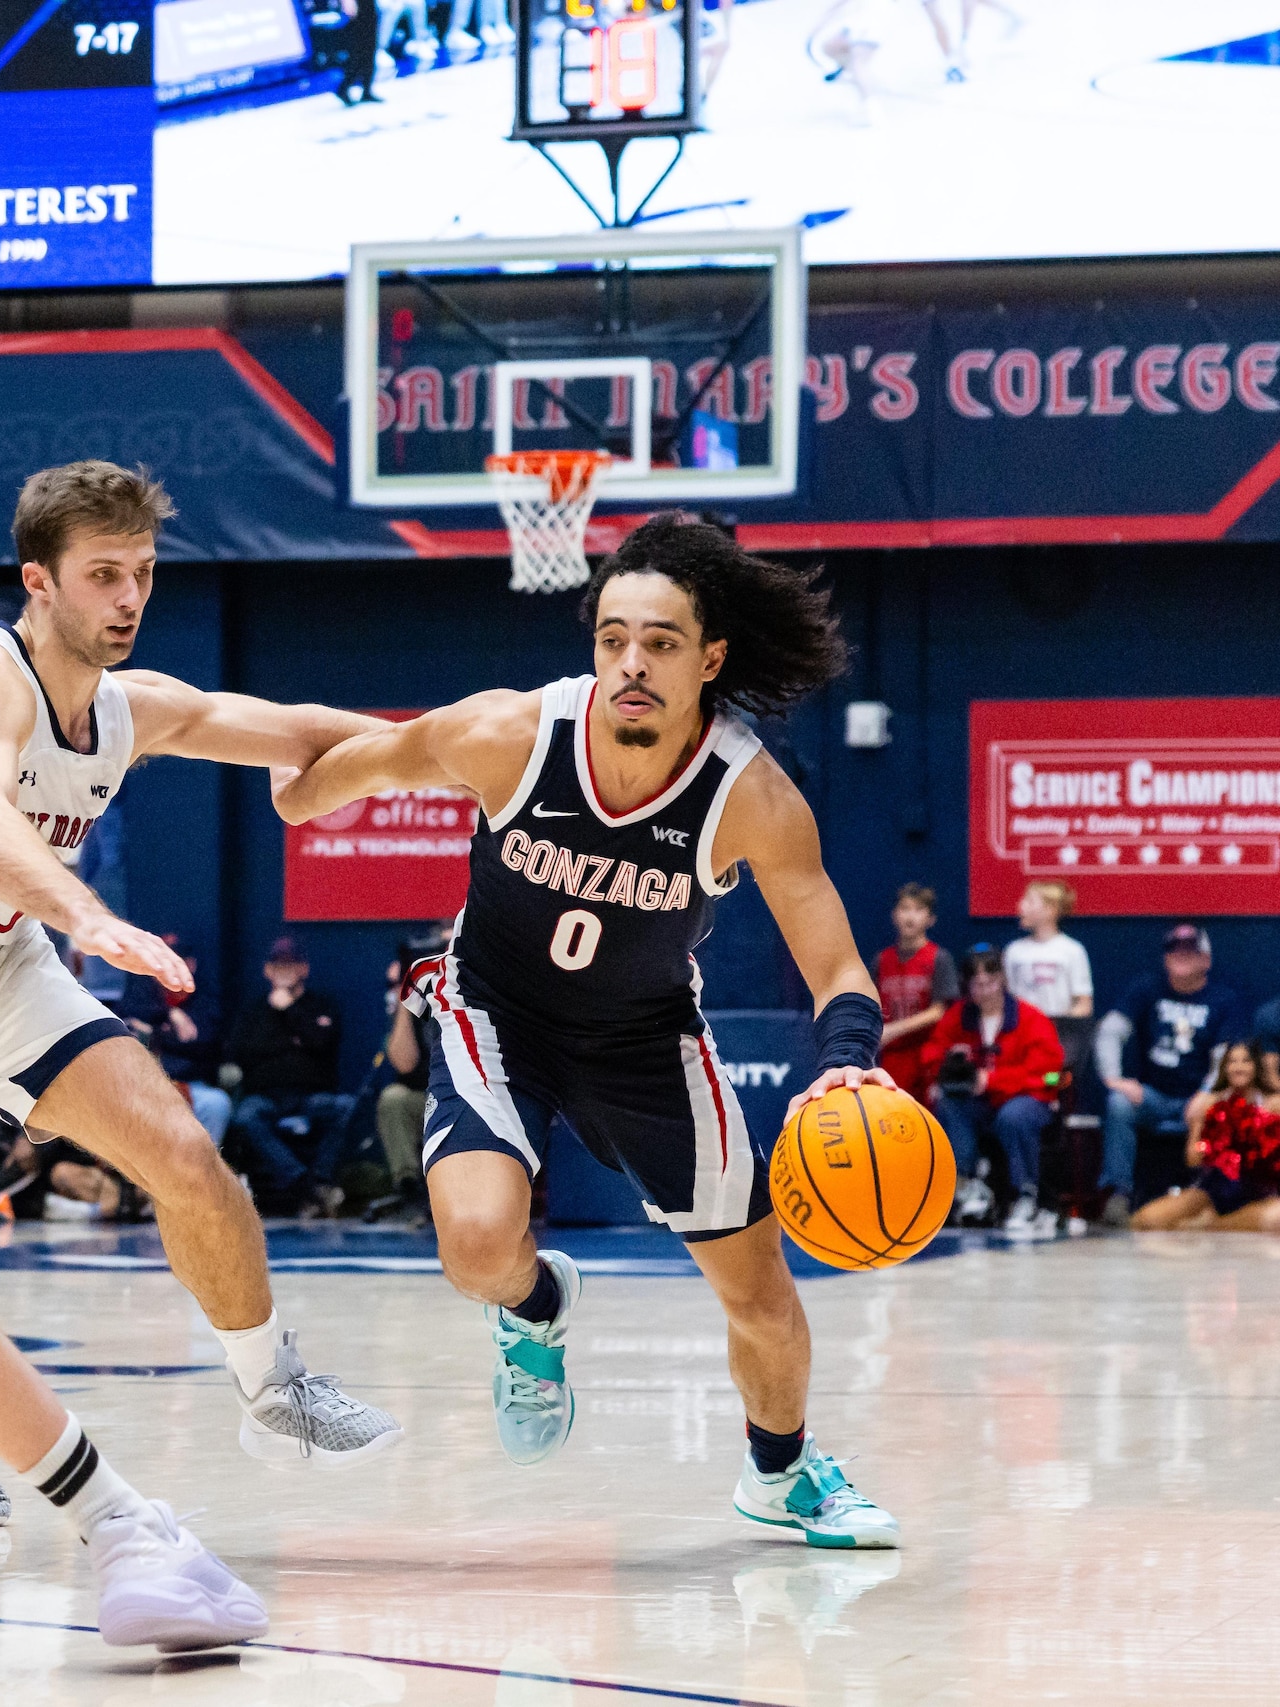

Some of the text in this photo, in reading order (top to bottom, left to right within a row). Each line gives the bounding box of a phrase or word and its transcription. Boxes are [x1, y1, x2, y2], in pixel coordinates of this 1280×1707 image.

[74, 22, 140, 56] 7-17
[948, 342, 1280, 420] COLLEGE
[370, 800, 460, 828] office
[651, 825, 690, 848] WCC
[500, 828, 693, 912] GONZAGA
[548, 908, 604, 972] 0
